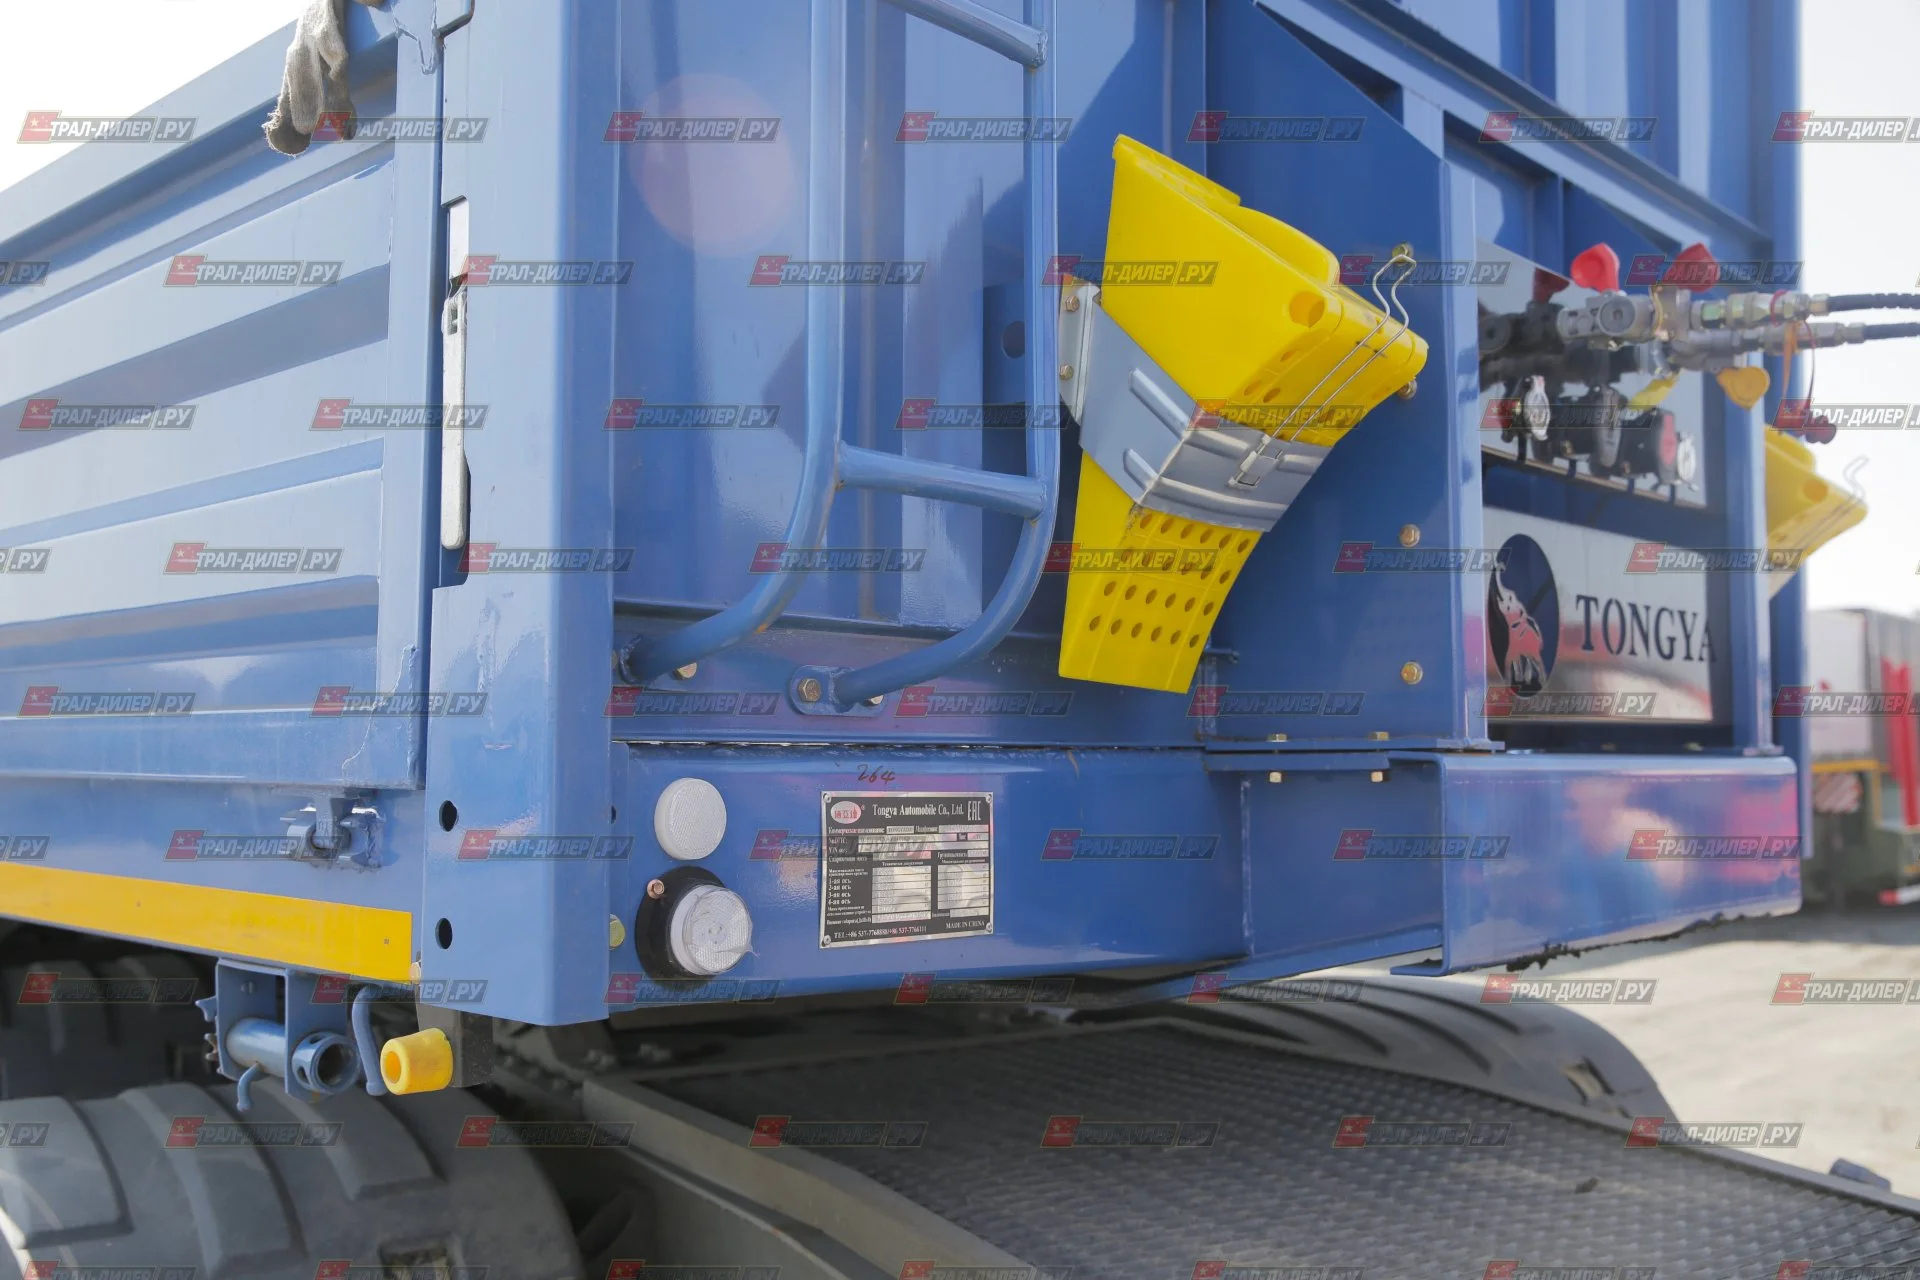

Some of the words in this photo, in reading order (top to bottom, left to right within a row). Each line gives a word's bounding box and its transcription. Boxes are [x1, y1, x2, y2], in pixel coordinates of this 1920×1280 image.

[1576, 594, 1718, 663] TONGYA
[857, 763, 896, 784] 264
[872, 804, 898, 819] Tongya
[899, 803, 937, 816] Automobile
[951, 803, 964, 815] Ltd.
